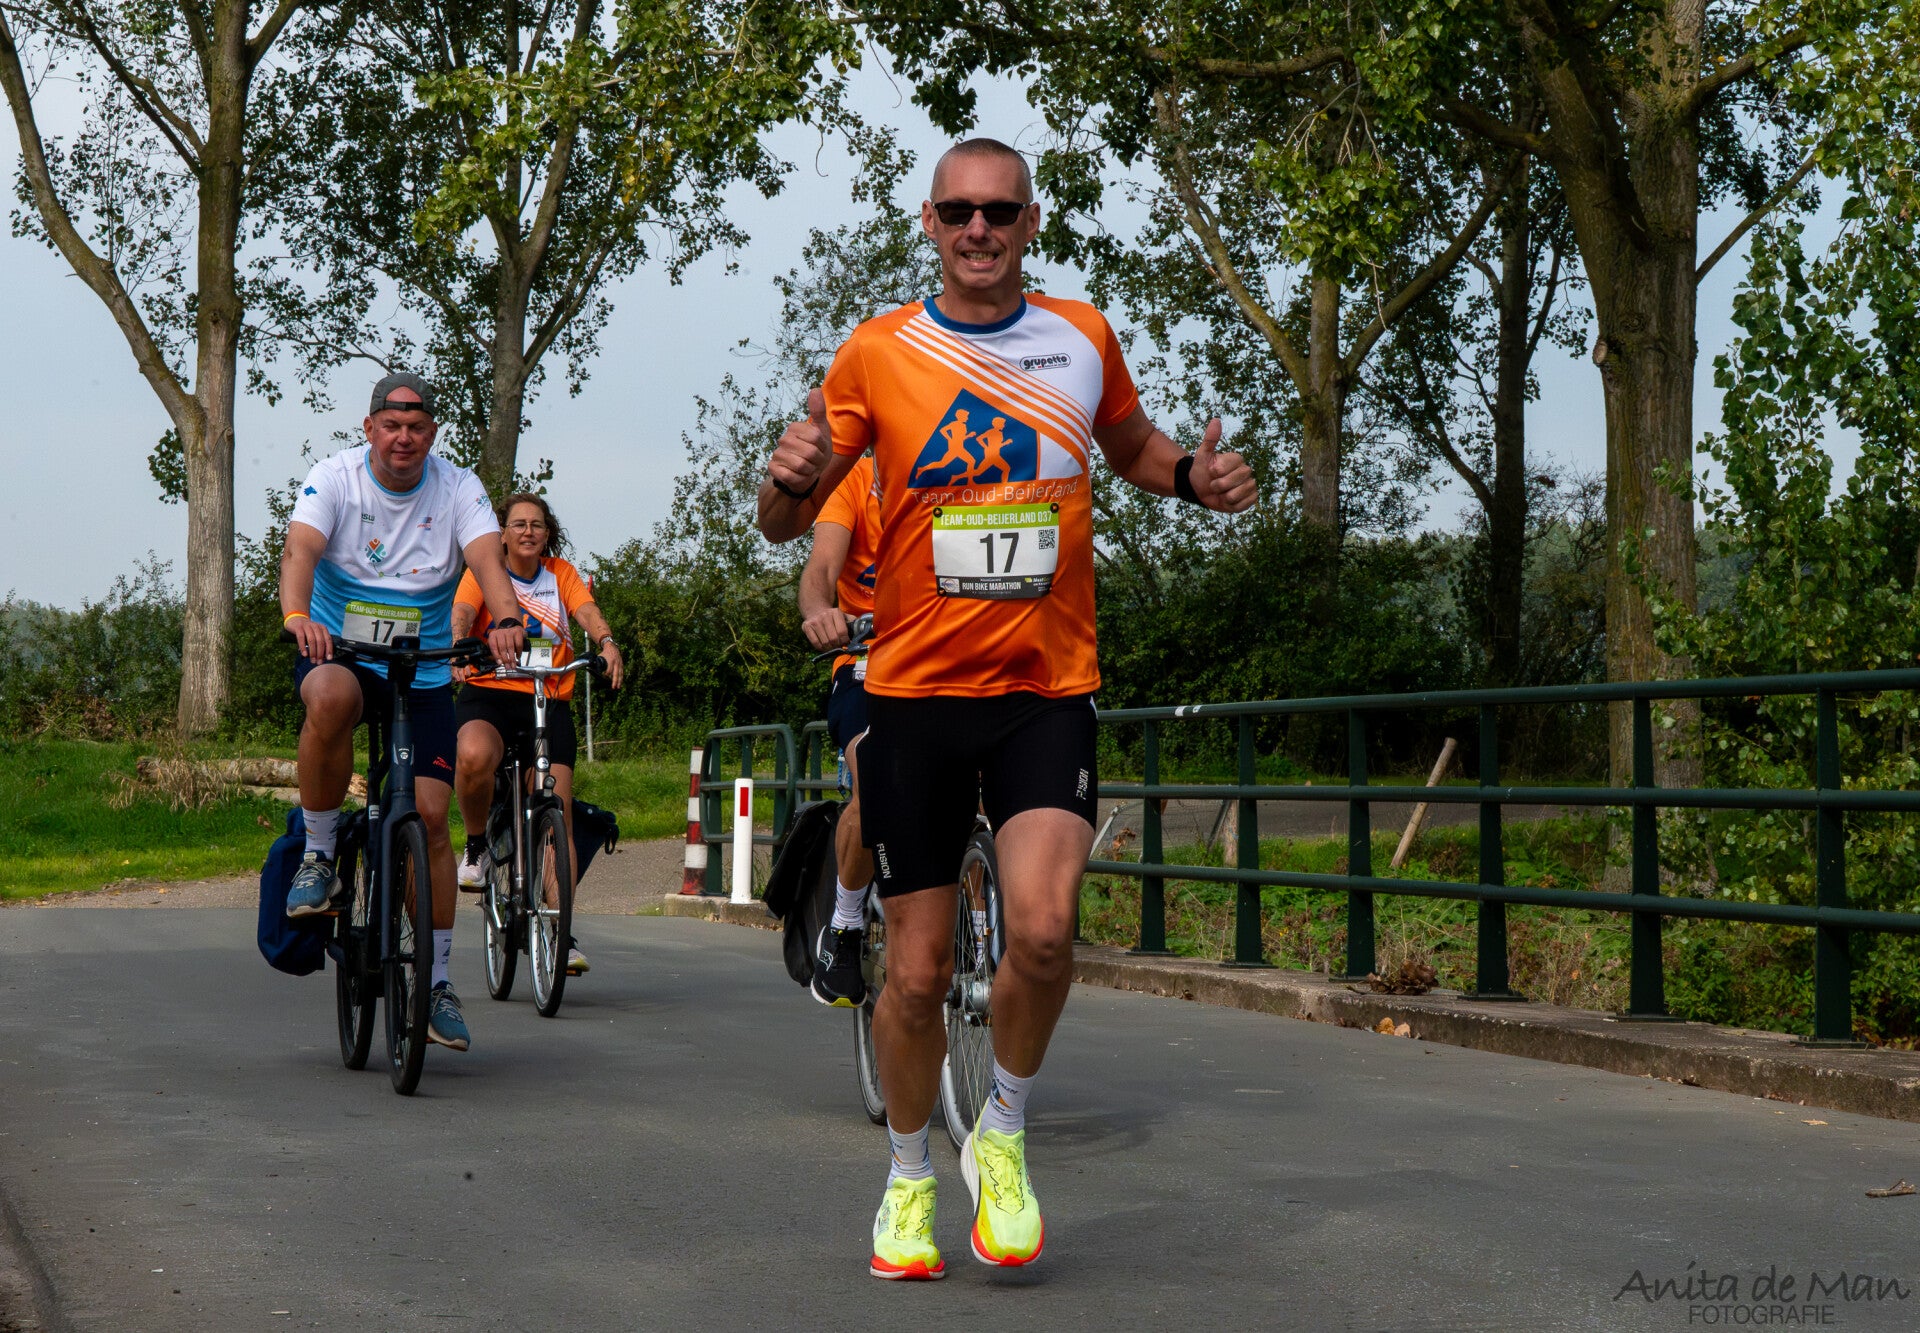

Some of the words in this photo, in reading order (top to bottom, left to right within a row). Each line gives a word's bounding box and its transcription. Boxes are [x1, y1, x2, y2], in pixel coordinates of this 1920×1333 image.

[911, 491, 955, 504] Team
[962, 479, 1078, 503] Oud-Beijerland
[940, 512, 1036, 526] TEAM-OUD-BEIJERLAND
[979, 532, 1020, 574] 17
[962, 582, 974, 591] RUN
[975, 582, 988, 591] BIKE
[989, 581, 1021, 591] MARATHON
[371, 619, 395, 644] 17
[876, 843, 892, 879] FUSION
